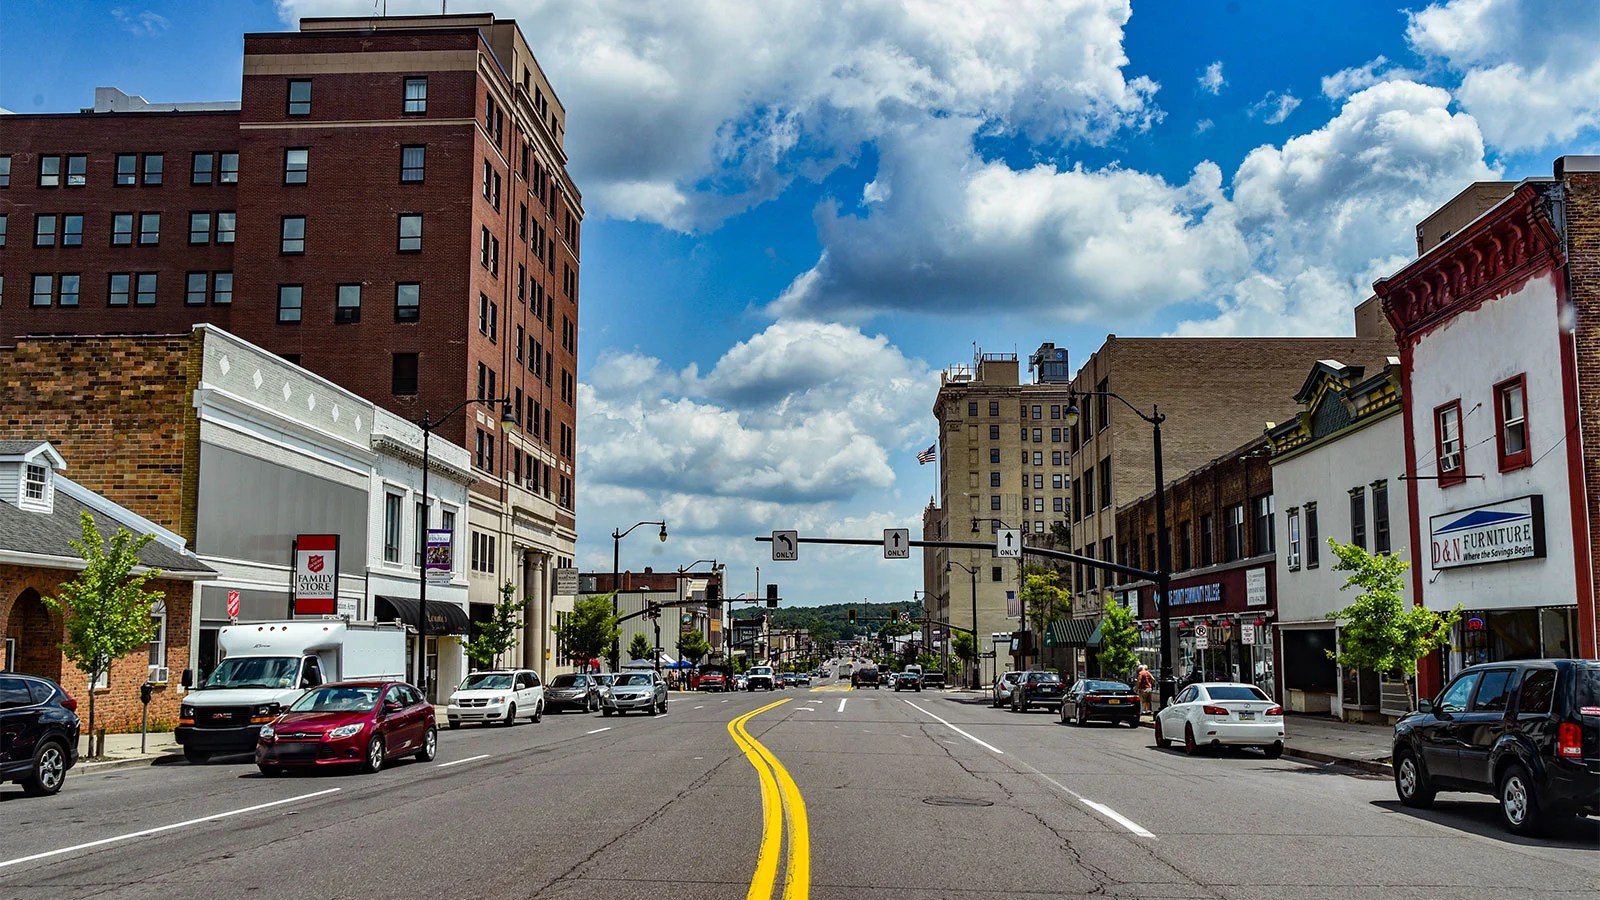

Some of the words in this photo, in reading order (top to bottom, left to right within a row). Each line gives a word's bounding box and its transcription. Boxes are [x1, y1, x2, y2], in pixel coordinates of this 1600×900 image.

[1433, 542, 1440, 563] D
[1443, 540, 1451, 562] &
[1453, 538, 1460, 560] N
[1463, 524, 1531, 549] FURNITURE
[1463, 552, 1480, 561] Where
[1491, 547, 1513, 558] Savings
[298, 574, 333, 583] FAMILY
[300, 583, 330, 591] STORE
[1205, 583, 1220, 602] COLLEGE
